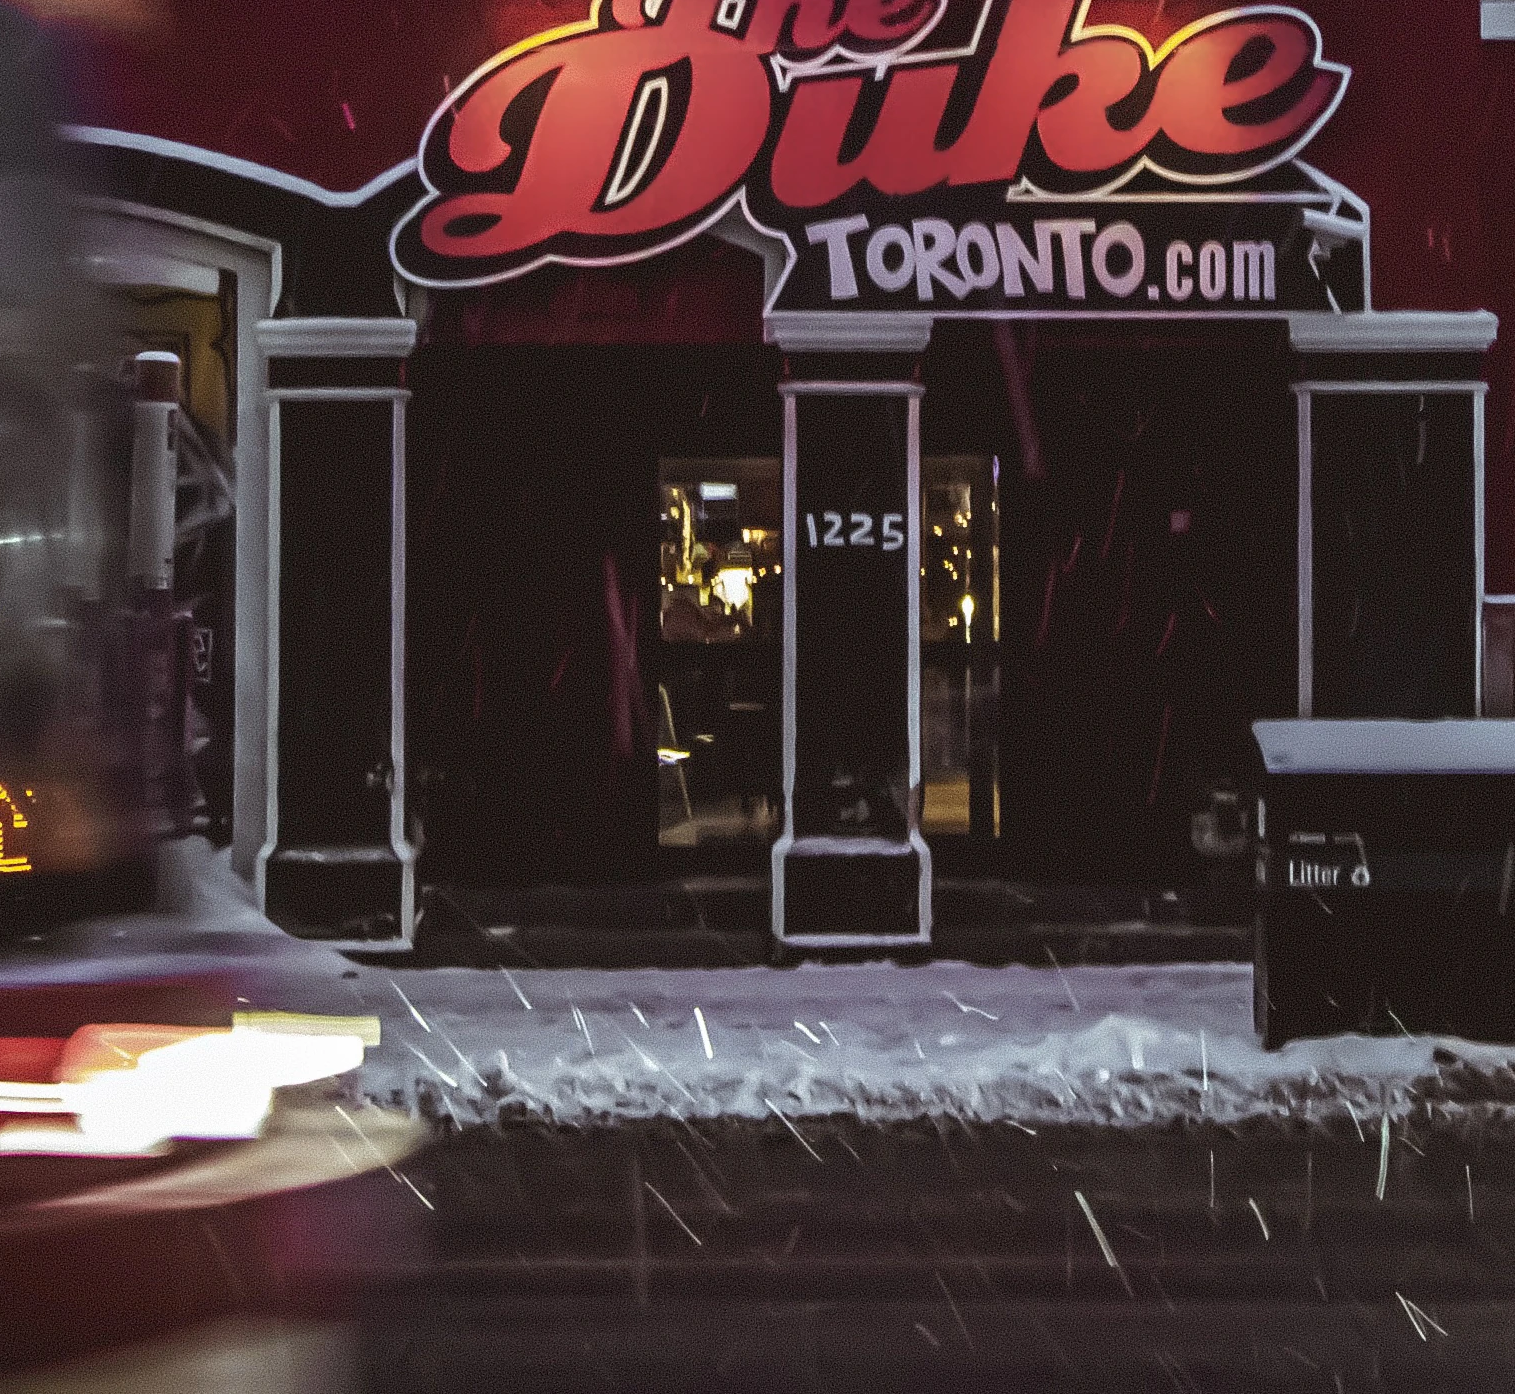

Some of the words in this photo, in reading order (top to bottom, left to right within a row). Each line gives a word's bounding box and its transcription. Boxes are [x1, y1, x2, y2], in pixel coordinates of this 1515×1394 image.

[804, 213, 1276, 303] TORONTO.com
[805, 510, 905, 552] 1225
[1288, 858, 1341, 887] Litter
